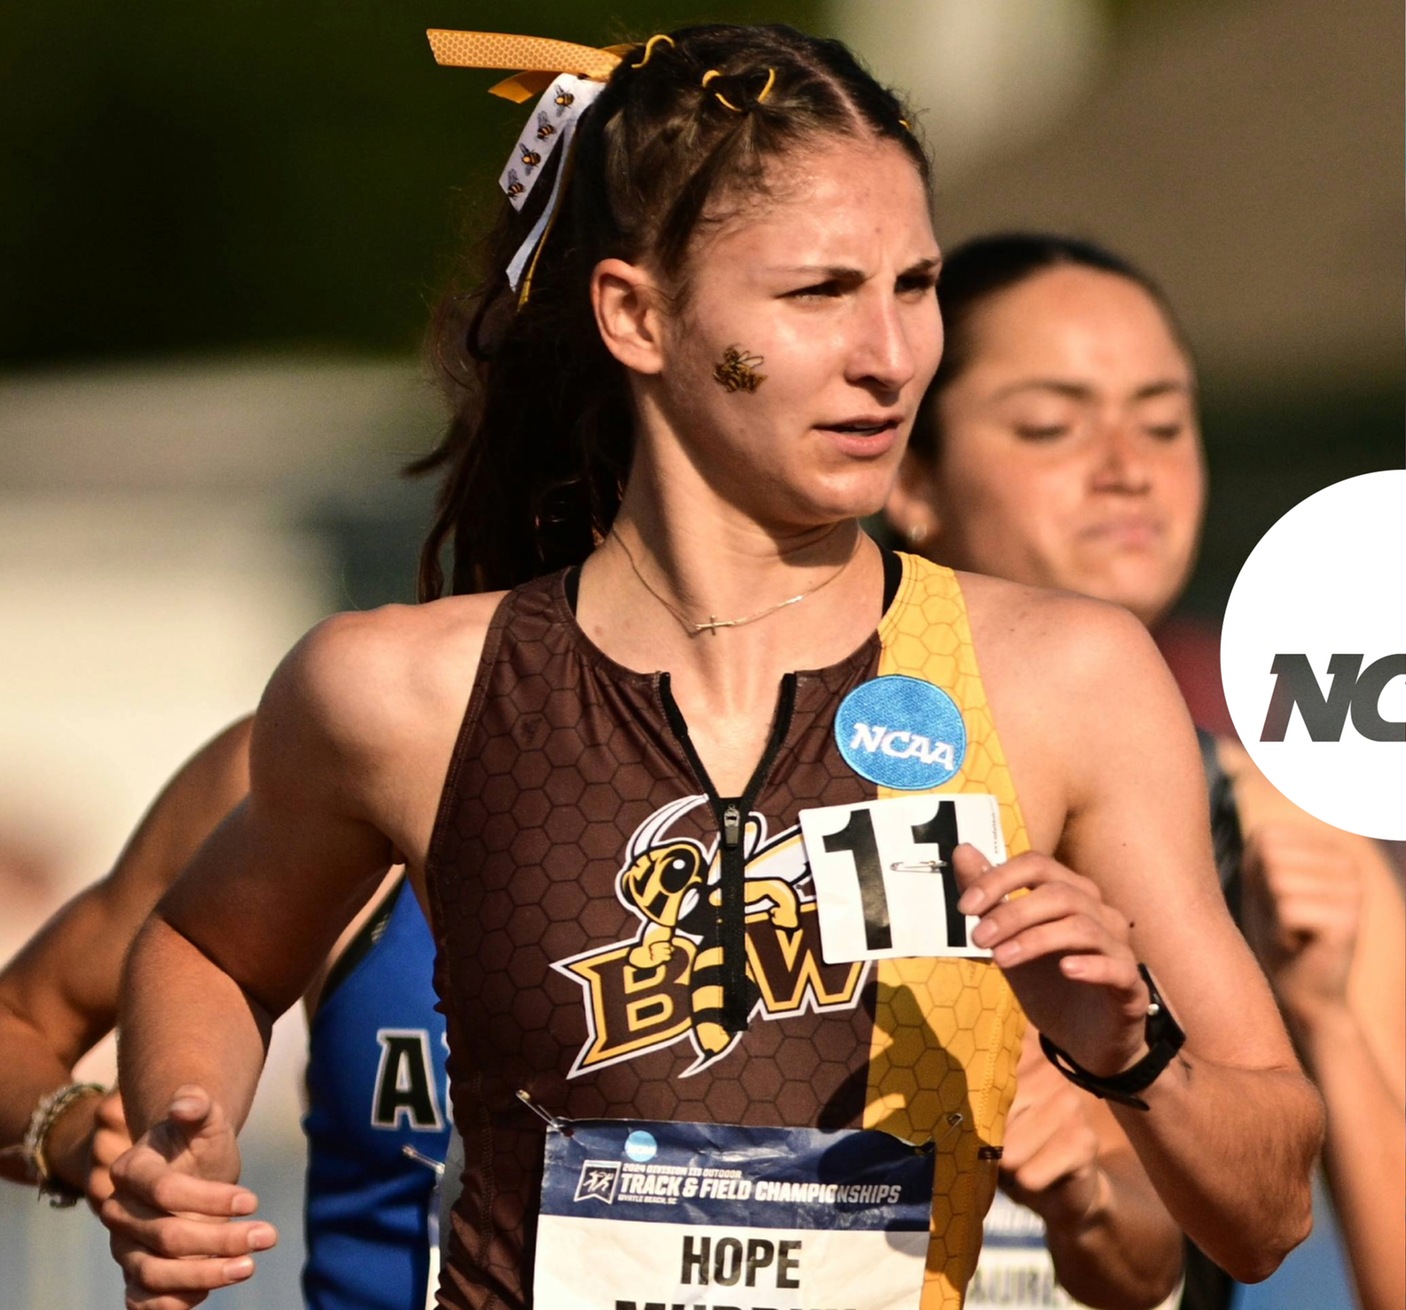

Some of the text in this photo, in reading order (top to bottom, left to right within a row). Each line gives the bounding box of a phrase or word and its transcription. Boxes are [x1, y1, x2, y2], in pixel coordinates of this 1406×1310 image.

[850, 722, 955, 771] NCAA
[822, 801, 967, 951] 11
[620, 1173, 902, 1204] TRACK & FIELD CHAMPIONSHIPS
[646, 1164, 688, 1176] DIVISION
[702, 1168, 743, 1179] OUTDOOR
[680, 1235, 802, 1289] HOPE
